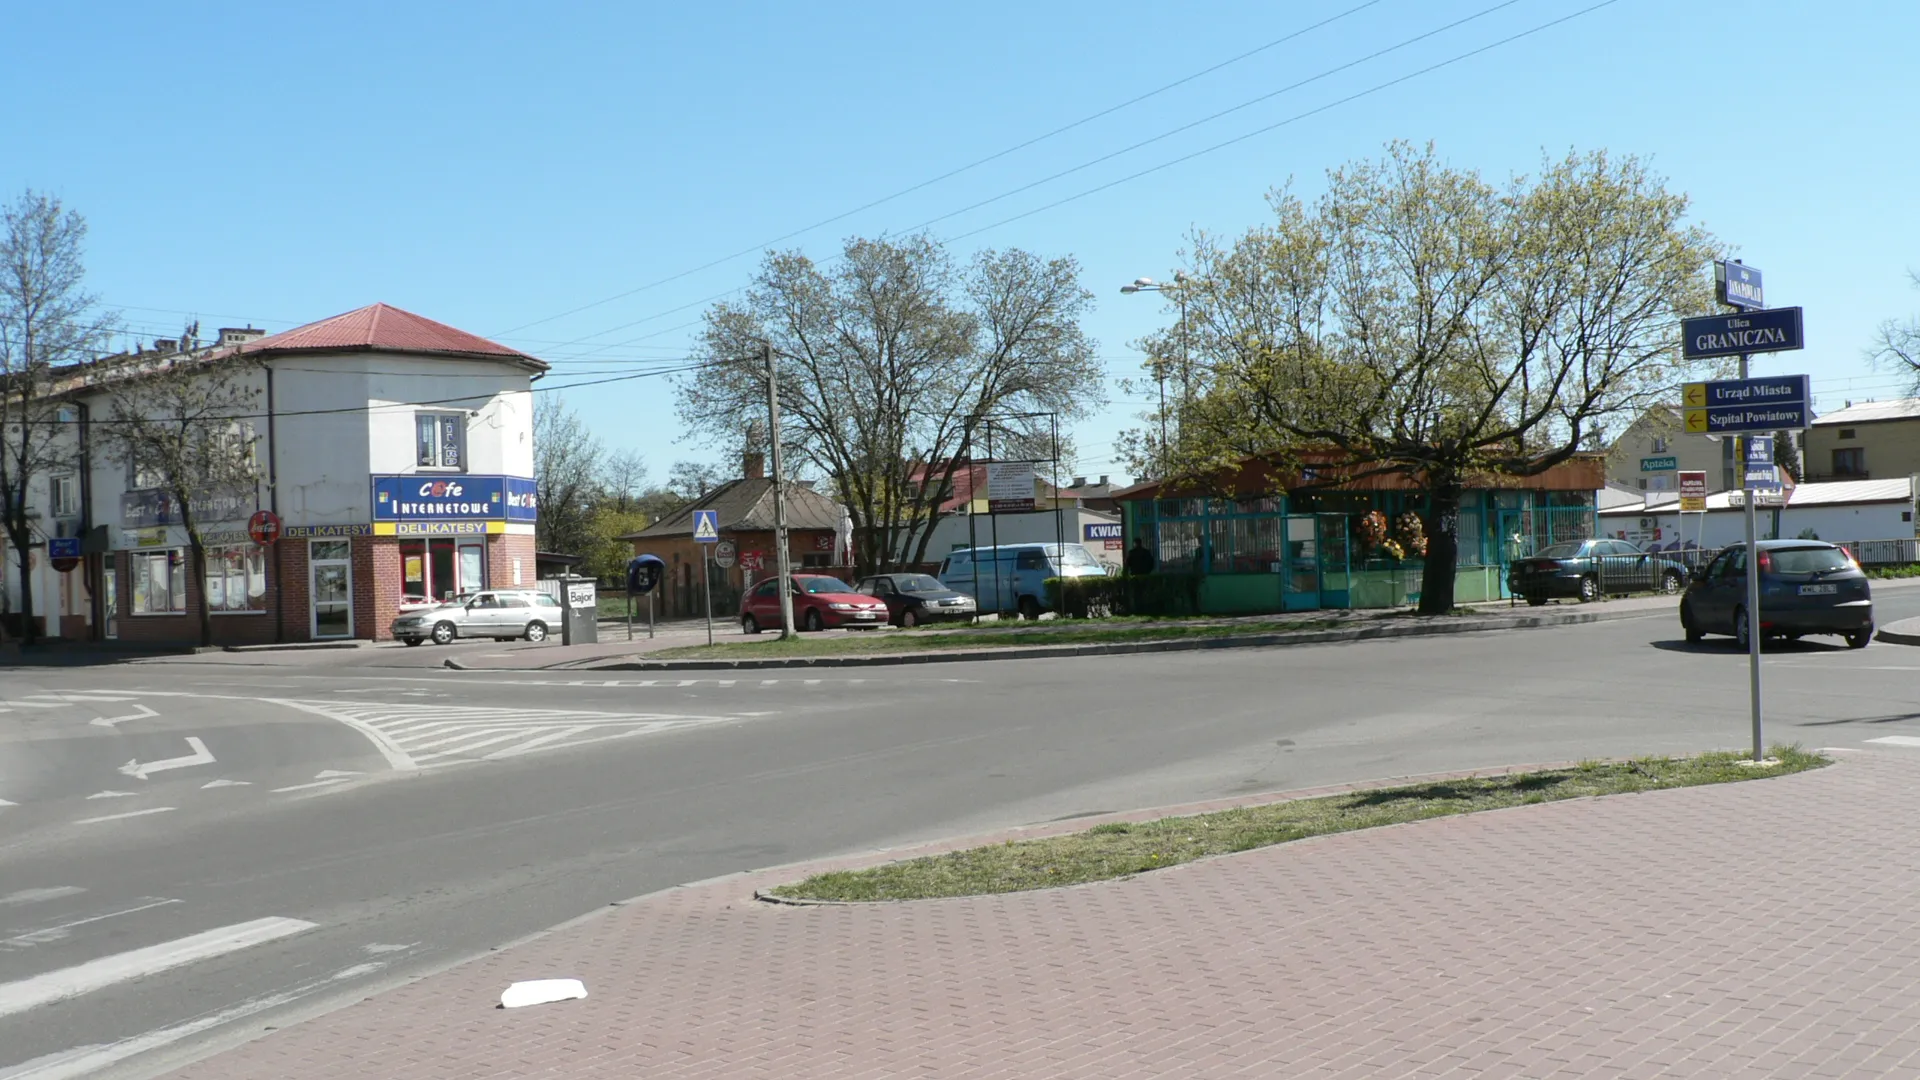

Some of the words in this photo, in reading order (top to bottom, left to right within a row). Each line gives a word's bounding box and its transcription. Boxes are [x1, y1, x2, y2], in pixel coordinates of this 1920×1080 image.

[1727, 319, 1750, 329] Ulica
[1696, 328, 1786, 350] GRANICZNA
[1716, 388, 1750, 400] Urząd
[1753, 385, 1792, 397] Miasta
[1710, 413, 1743, 427] Szpital
[1746, 410, 1800, 424] Powiatowy
[1643, 459, 1675, 469] Apteka
[507, 491, 520, 506] Best
[392, 499, 489, 514] INTERNETOWE
[288, 525, 368, 537] DELIKATESY
[399, 523, 484, 533] DELIKATESY
[570, 591, 593, 605] Bajor
